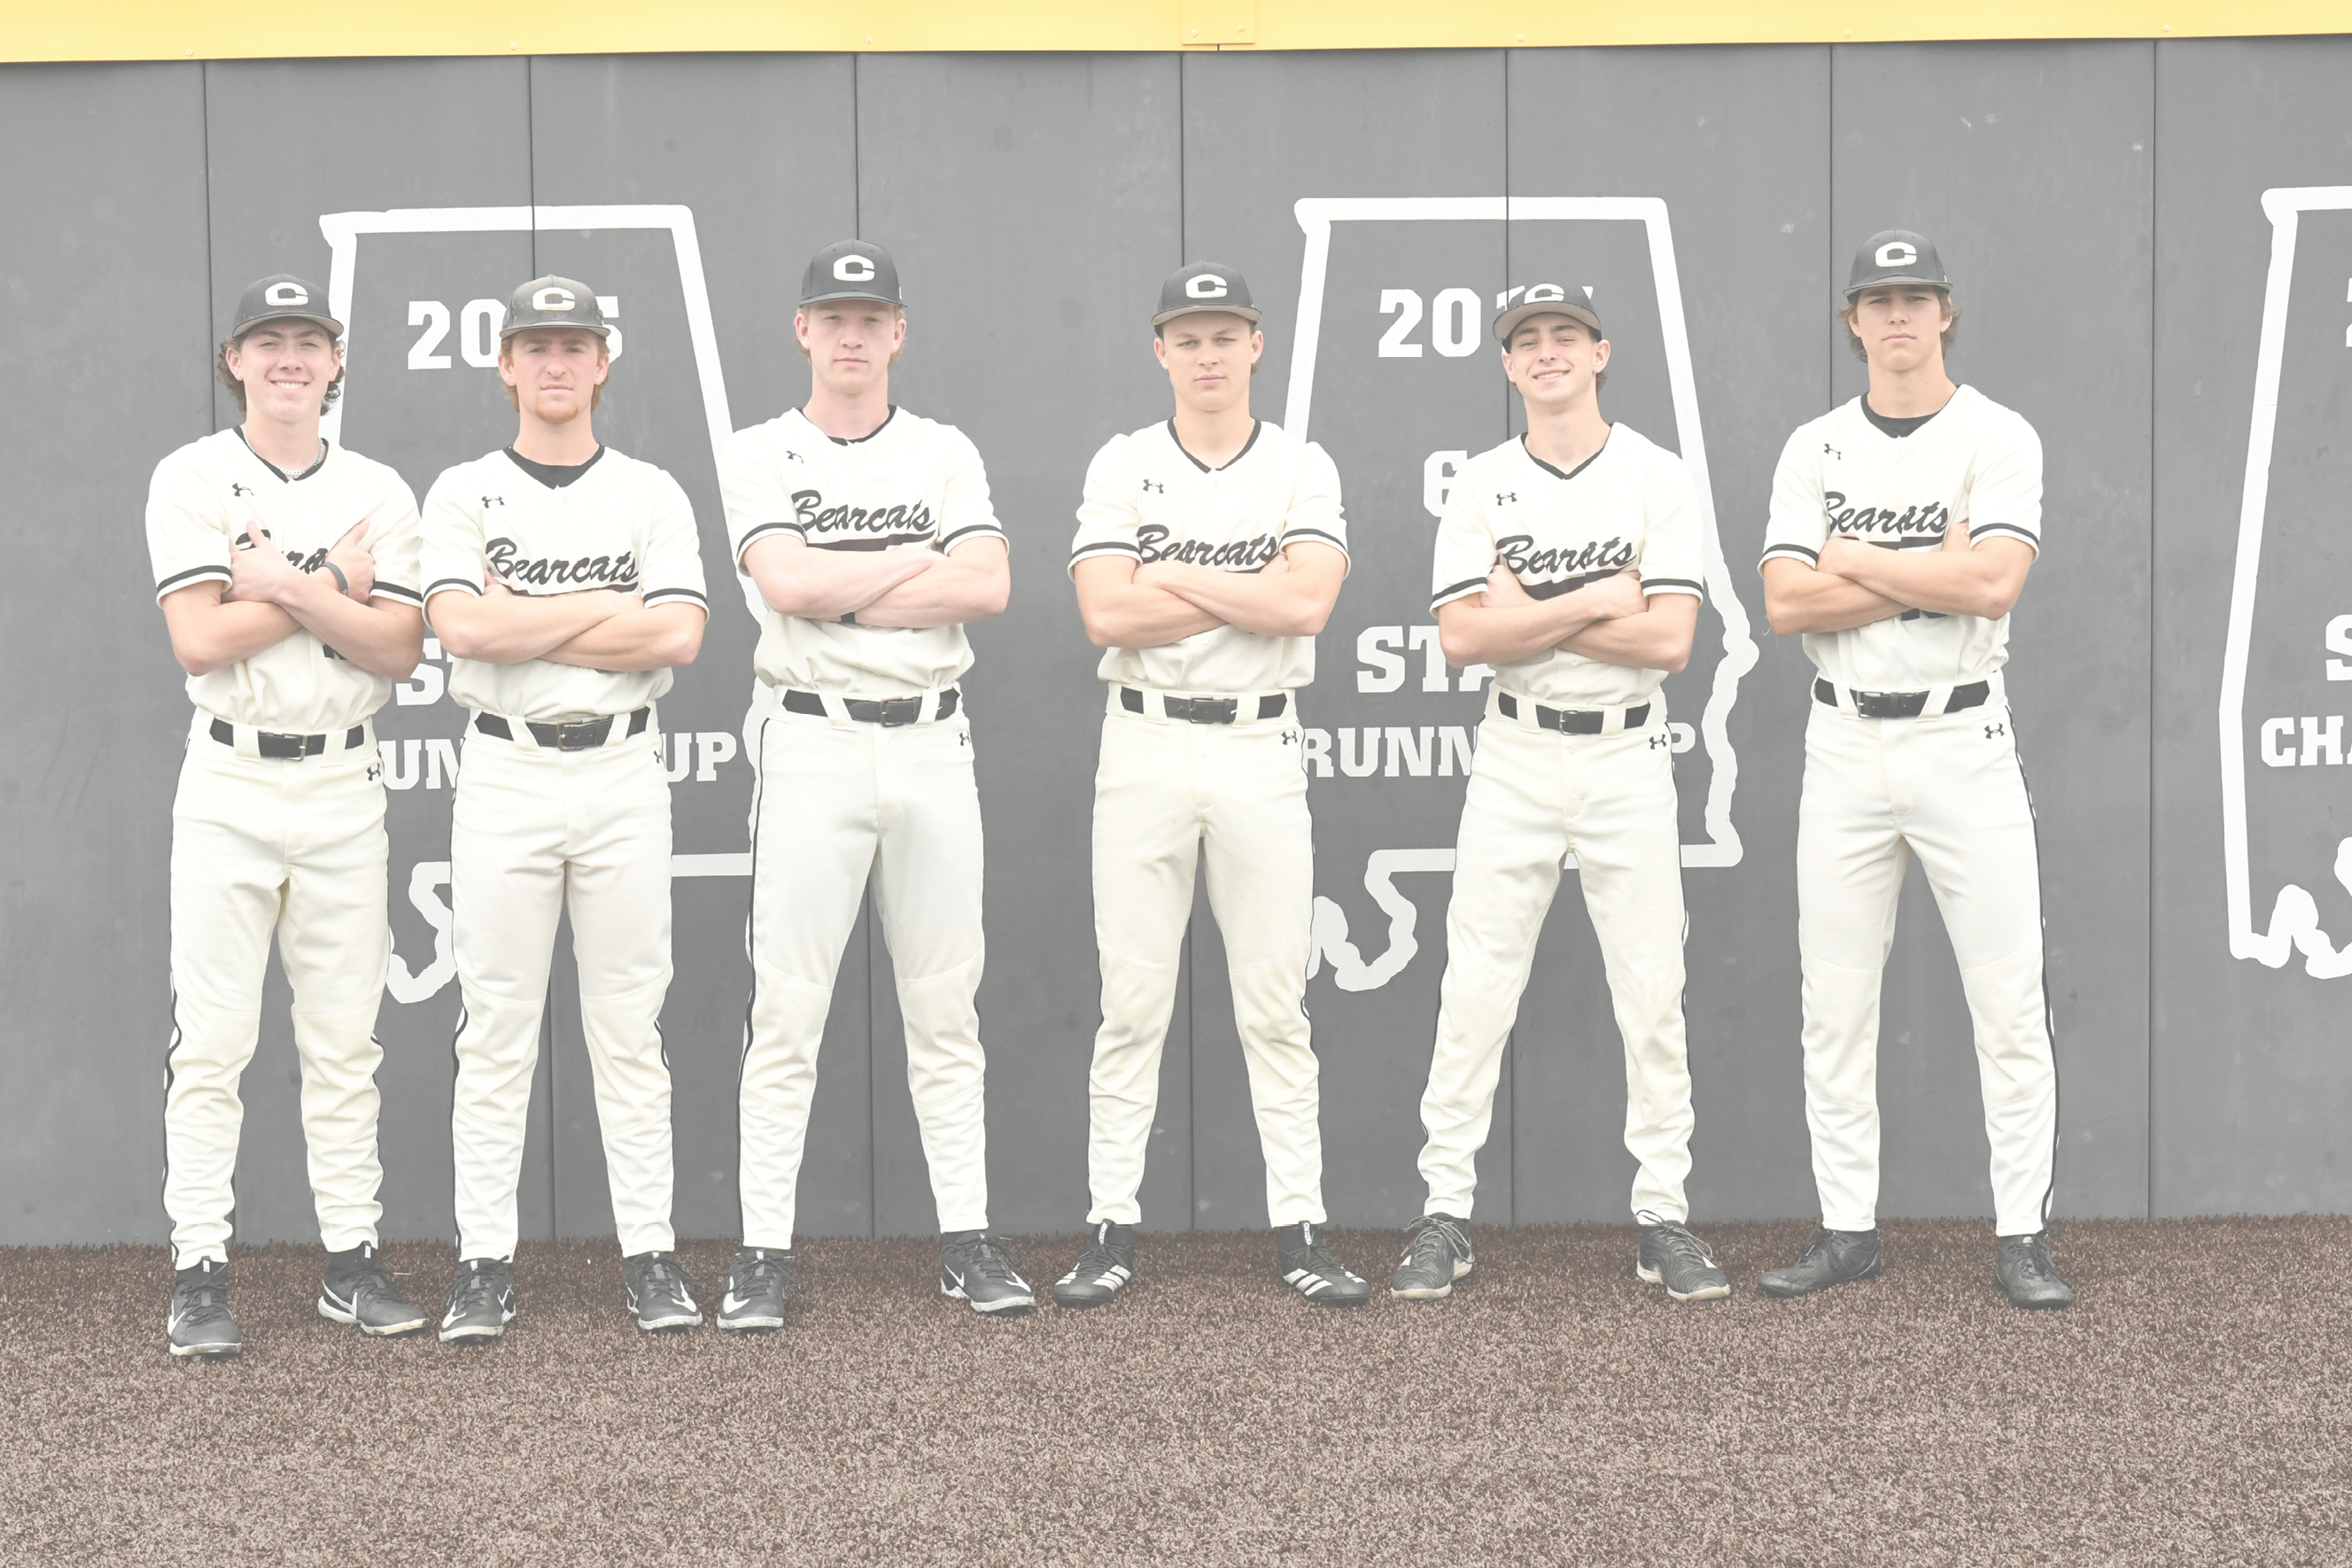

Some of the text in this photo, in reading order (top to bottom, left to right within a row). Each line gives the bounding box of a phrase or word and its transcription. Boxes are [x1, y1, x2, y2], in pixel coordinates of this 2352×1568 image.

[833, 253, 875, 282] C
[1875, 241, 1918, 268] C
[265, 282, 309, 307] C
[532, 287, 576, 311] C
[1185, 273, 1228, 299] C
[1524, 283, 1565, 305] C
[485, 537, 639, 586] Bearcats
